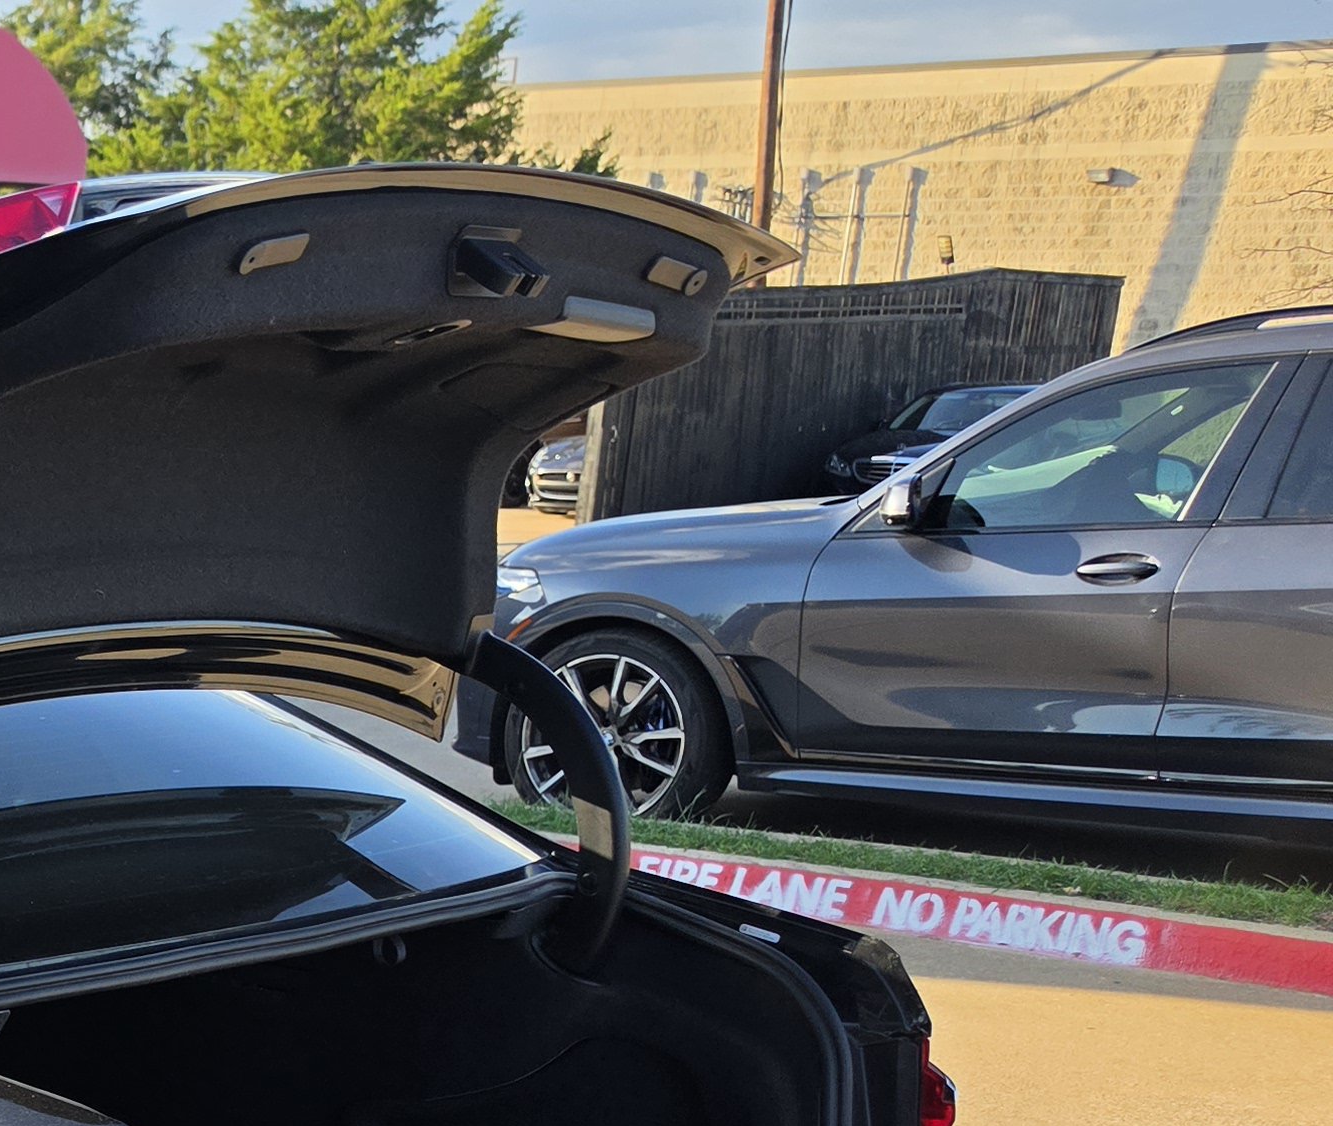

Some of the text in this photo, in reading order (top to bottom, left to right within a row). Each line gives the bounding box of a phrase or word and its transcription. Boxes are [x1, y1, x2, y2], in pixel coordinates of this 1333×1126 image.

[730, 867, 853, 919] LANE
[870, 887, 946, 932] NO
[949, 896, 1148, 966] PARKING
